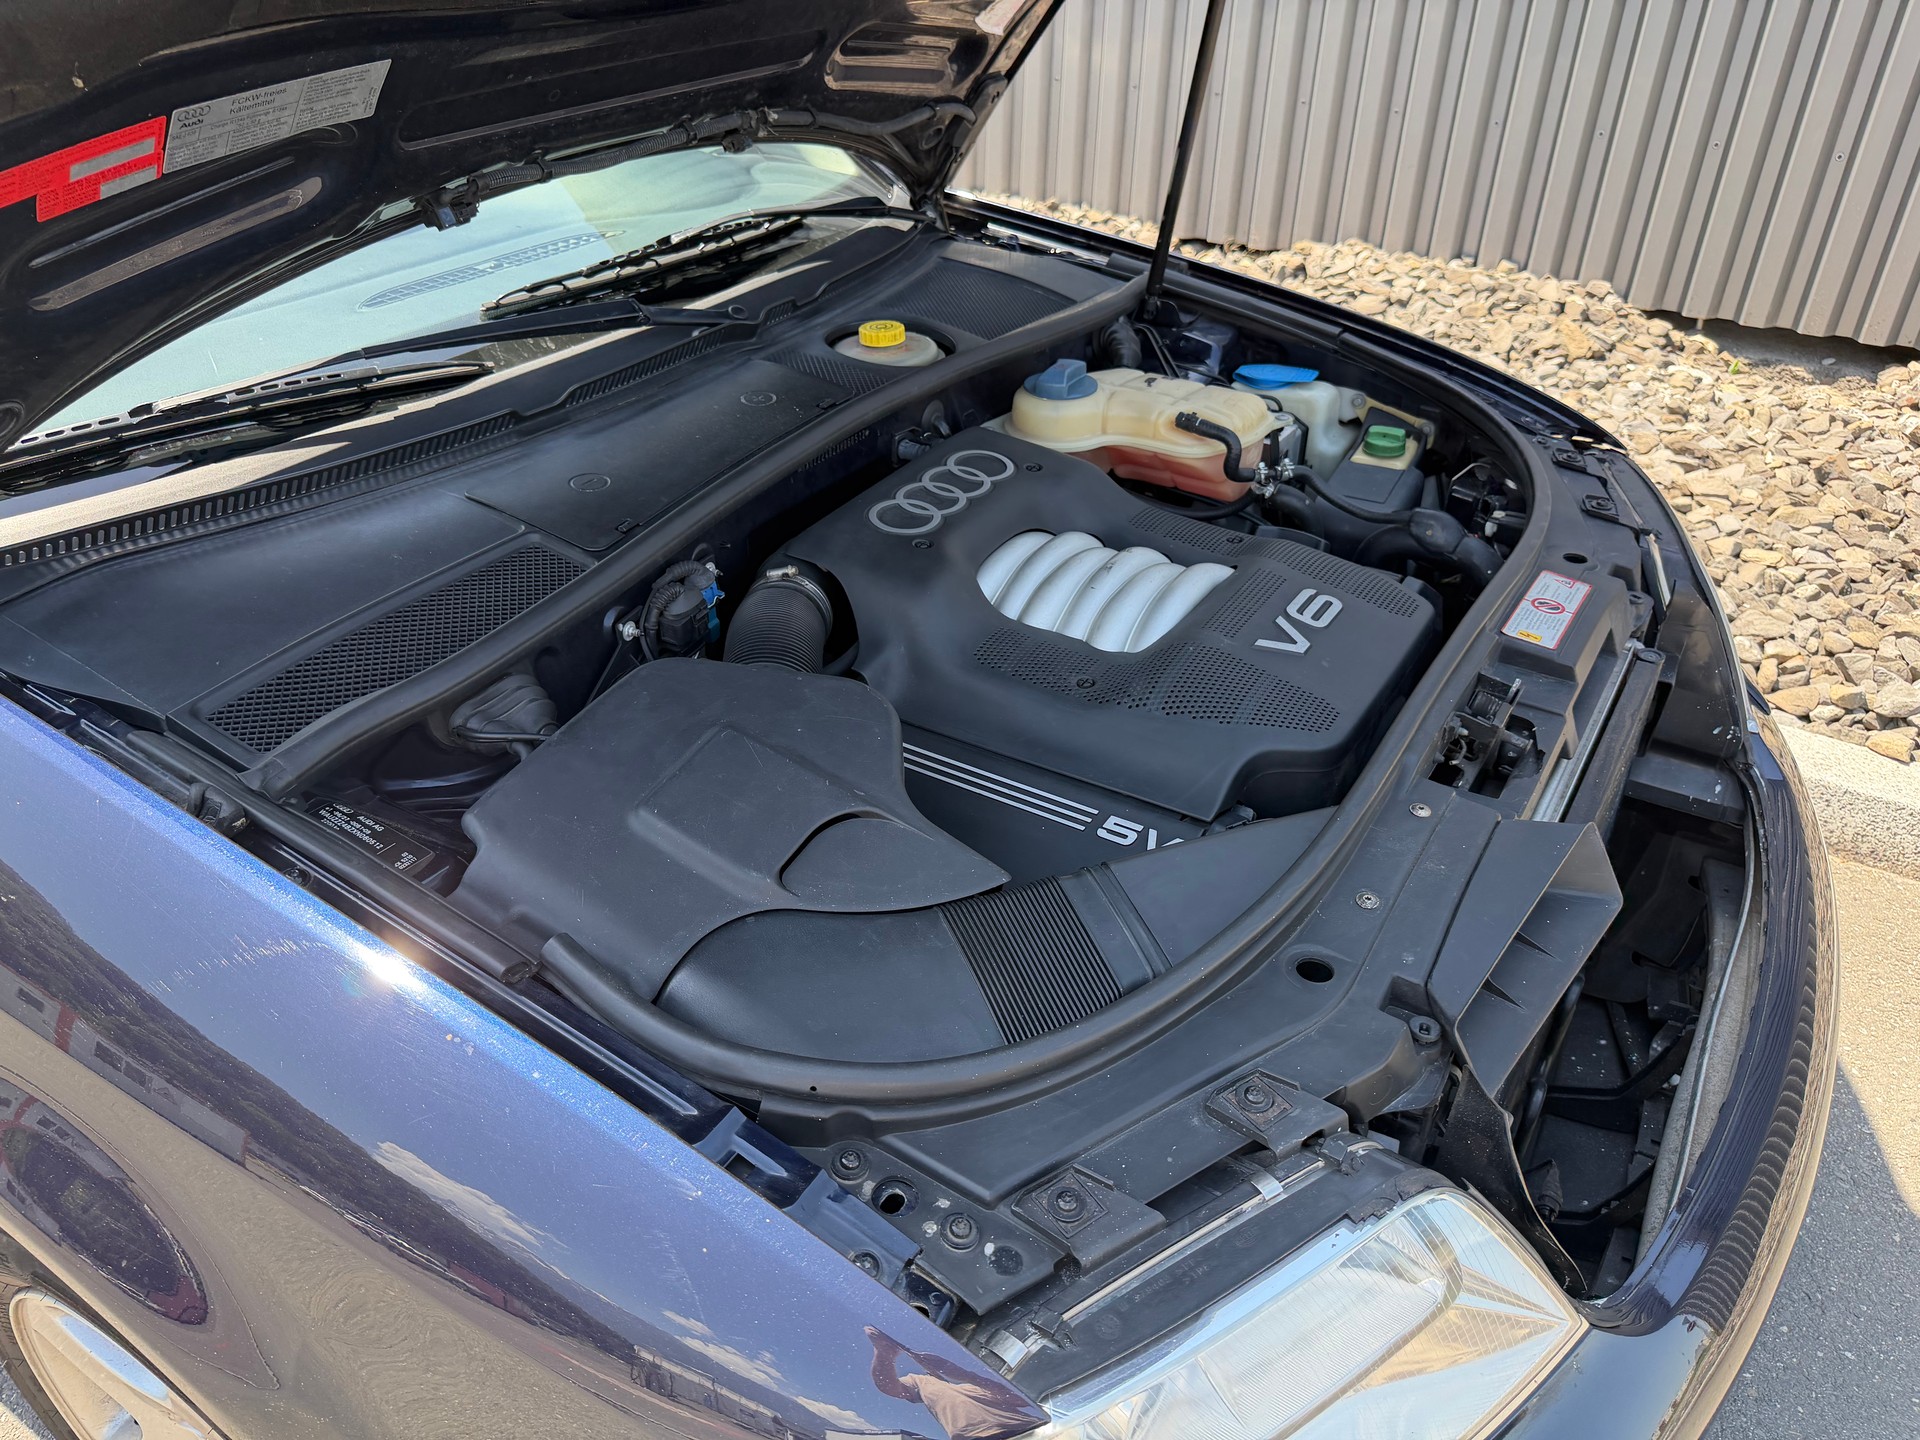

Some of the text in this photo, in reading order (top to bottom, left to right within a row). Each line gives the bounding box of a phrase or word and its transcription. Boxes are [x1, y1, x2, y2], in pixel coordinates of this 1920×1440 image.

[231, 87, 287, 106] FCKW-freies
[229, 97, 276, 115] Kältemittel
[179, 118, 204, 130] Audi
[1254, 588, 1343, 654] V6
[357, 815, 385, 832] AUDI AG
